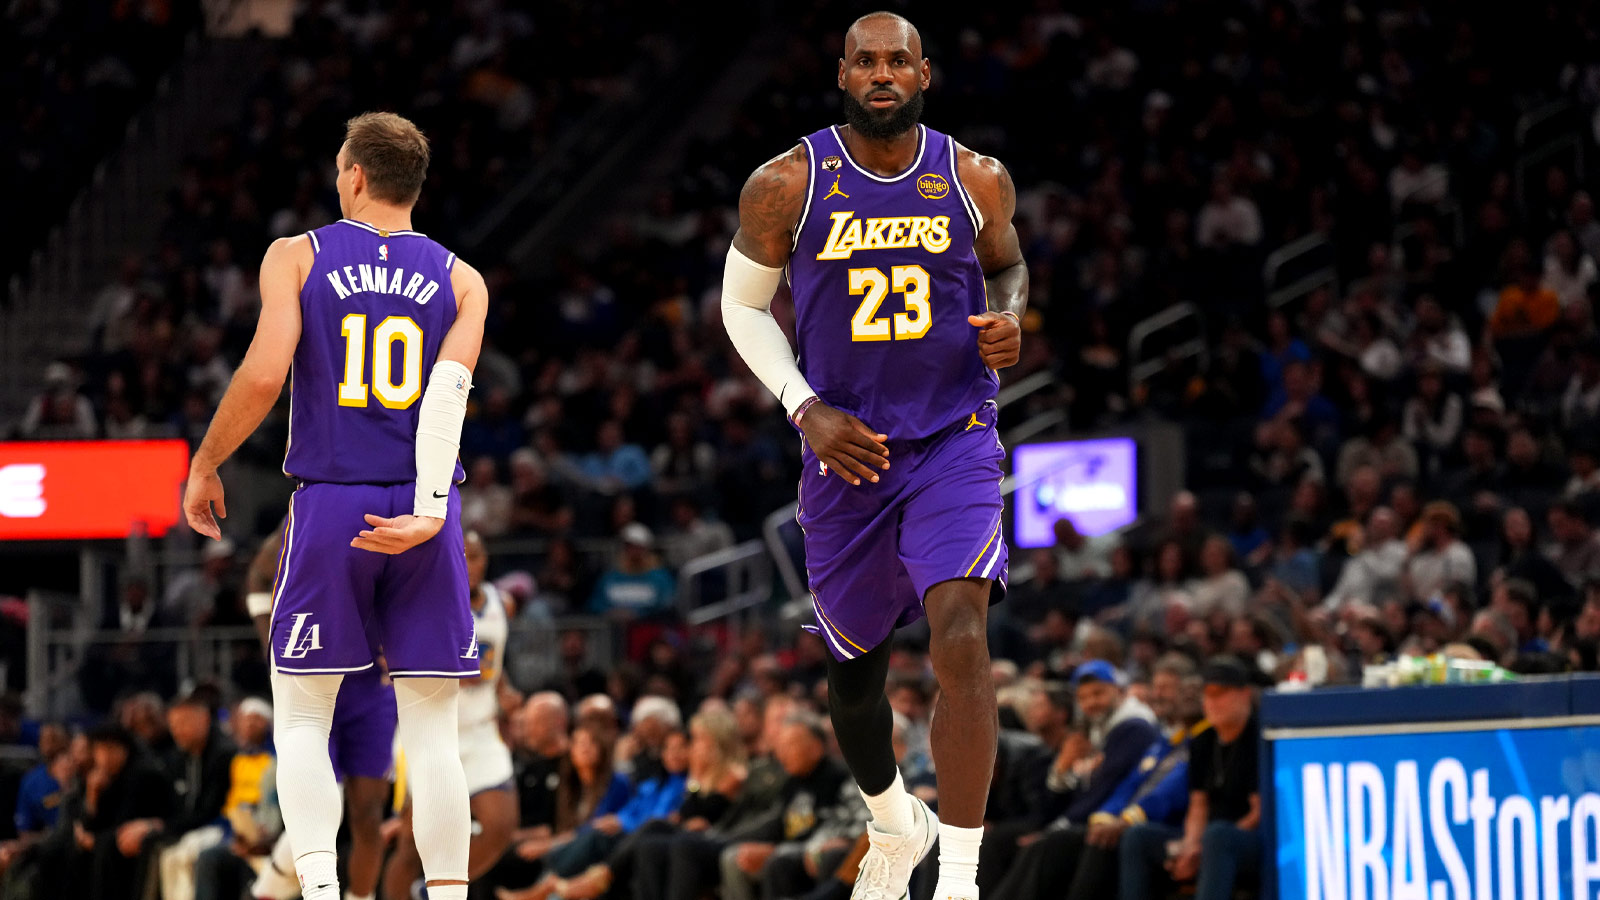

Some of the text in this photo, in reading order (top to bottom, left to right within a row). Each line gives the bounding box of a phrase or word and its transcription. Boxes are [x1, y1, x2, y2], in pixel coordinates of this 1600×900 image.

[920, 180, 947, 192] bibigo
[816, 211, 952, 260] LAKERS
[326, 263, 440, 305] KENNARD
[848, 264, 933, 342] 23
[338, 313, 424, 410] 10
[279, 612, 324, 659] LA
